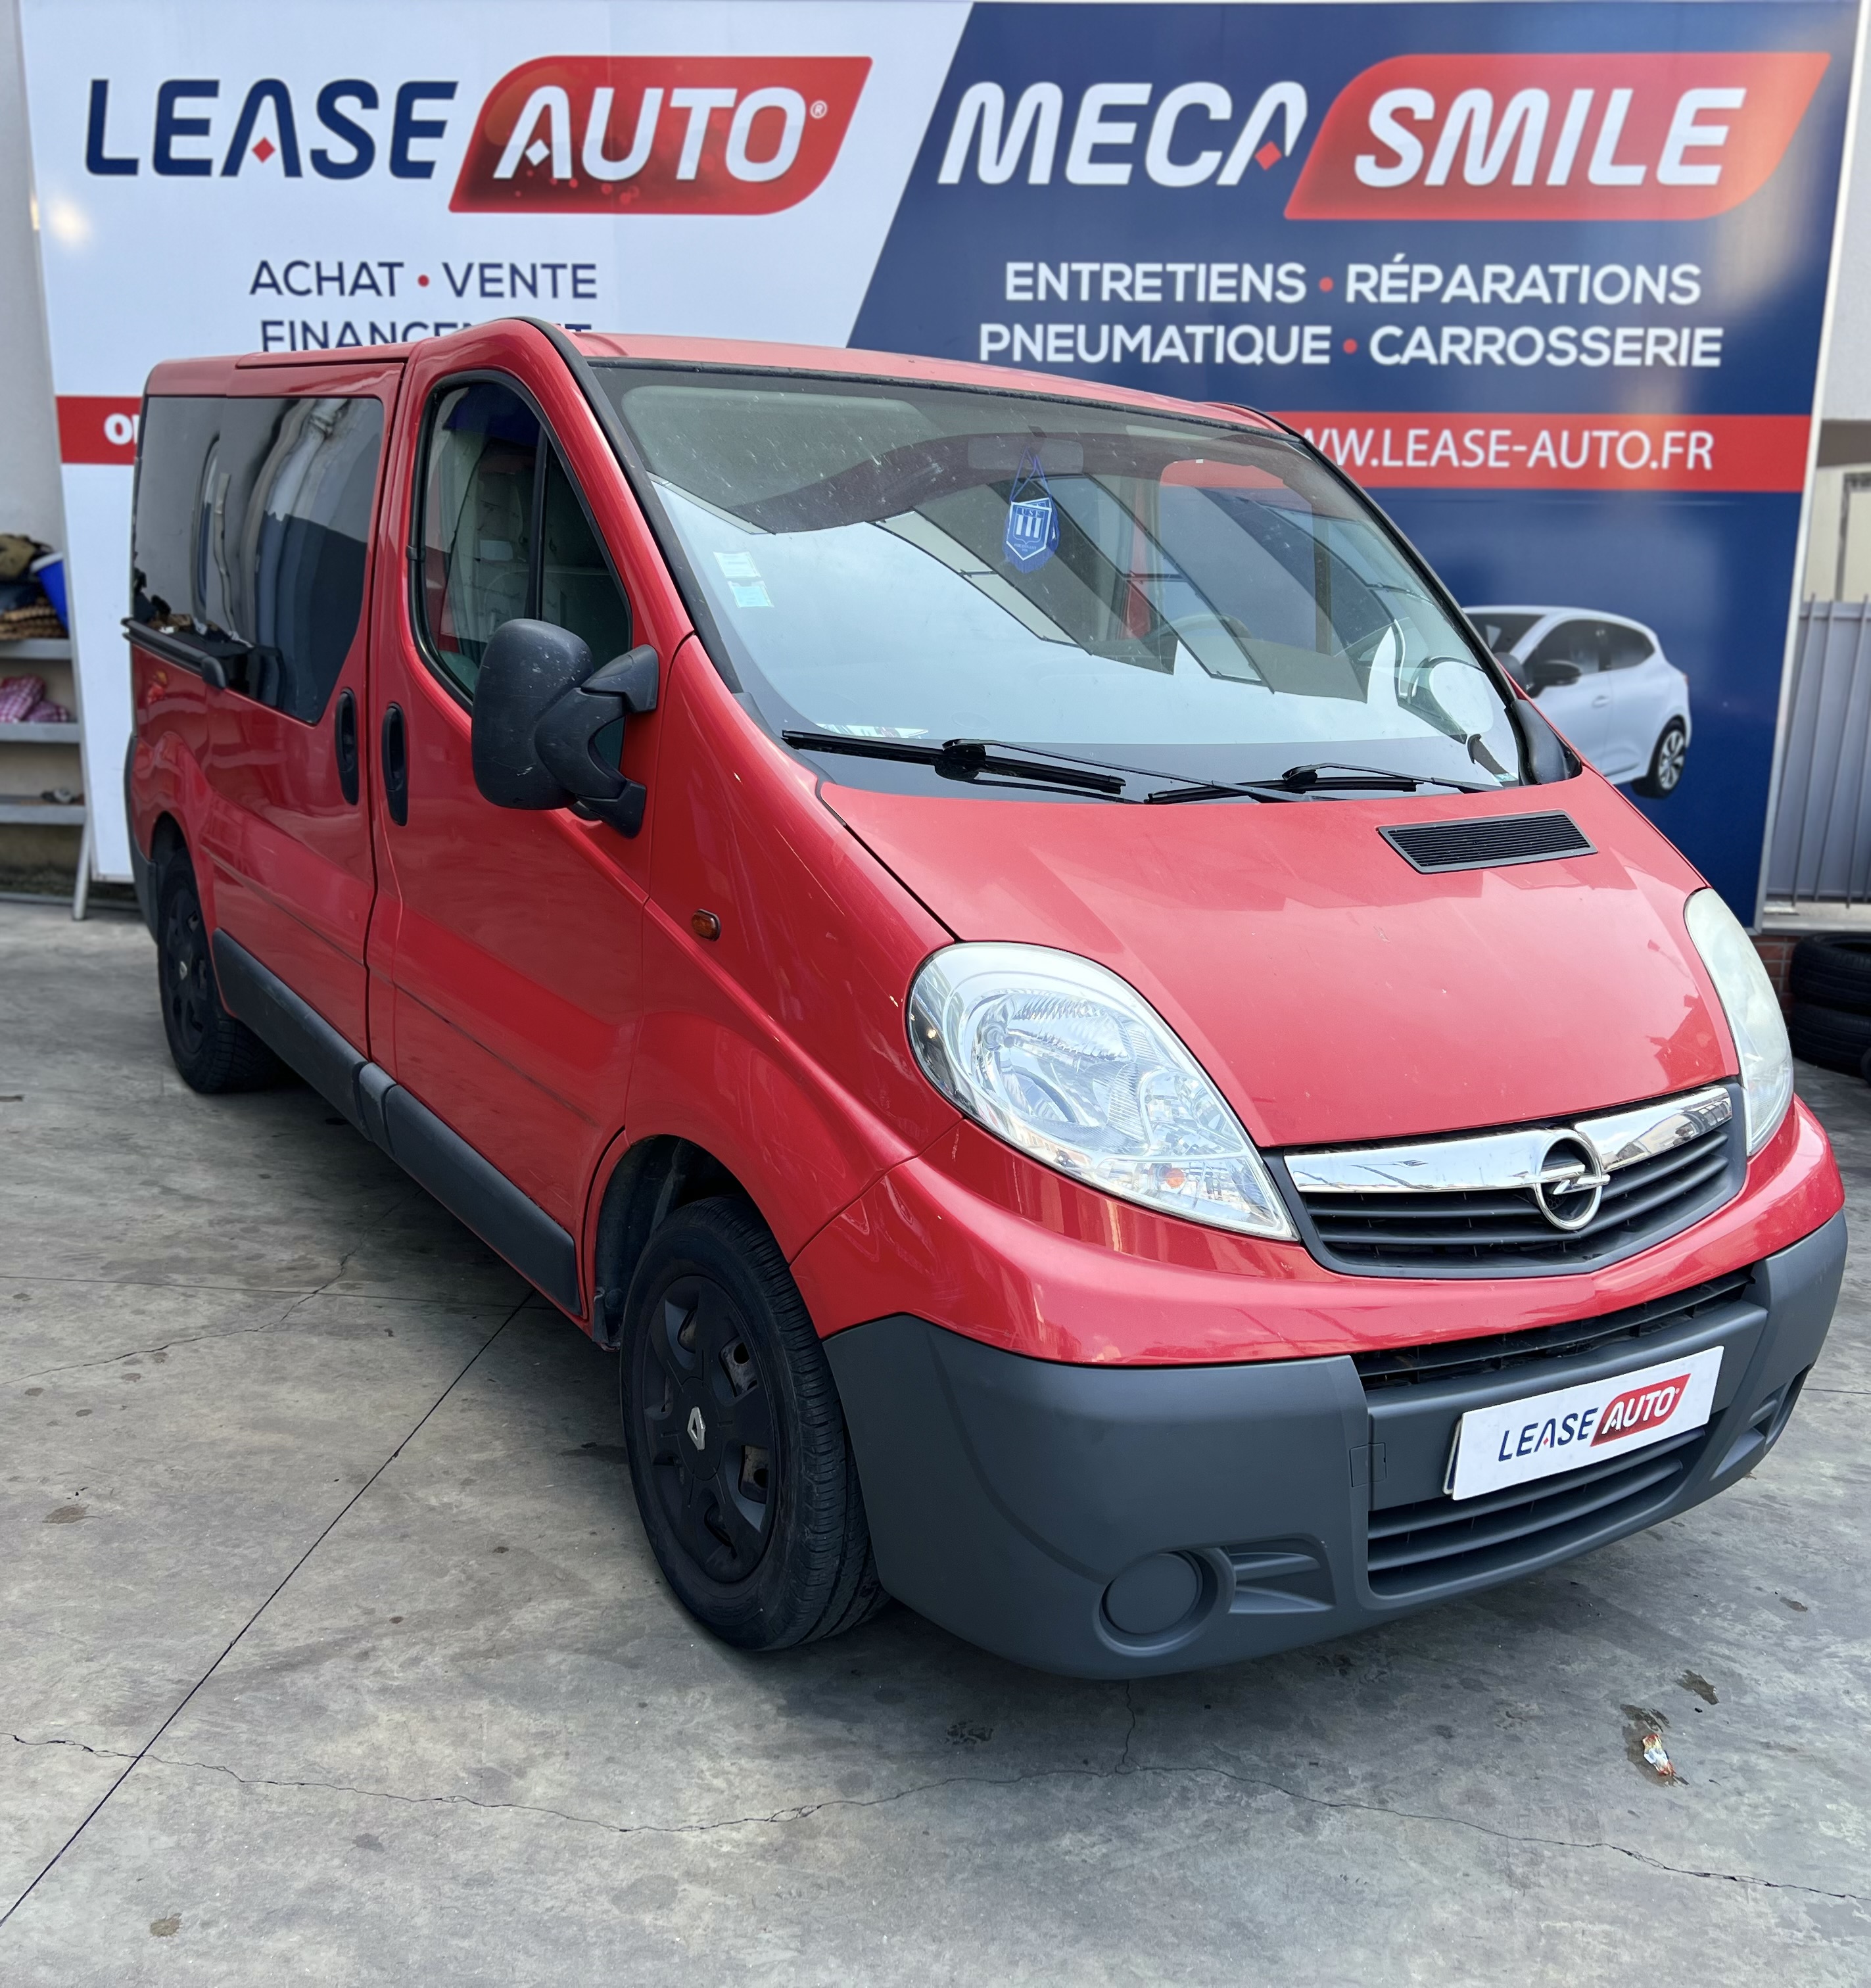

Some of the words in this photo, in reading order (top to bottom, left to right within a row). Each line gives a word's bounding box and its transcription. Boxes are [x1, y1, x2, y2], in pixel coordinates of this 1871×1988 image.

[85, 79, 459, 180] LEASE
[937, 81, 1308, 187] MECA
[1354, 87, 1747, 189] SMILE
[249, 260, 404, 297] ACHAT
[442, 262, 598, 299] VENTE
[1005, 262, 1307, 304] ENTRETIENS
[1346, 253, 1702, 306] RÉPARATIONS
[979, 323, 1332, 367] PNEUMATIQUE
[1369, 325, 1724, 367] CARROSSERIE
[1498, 1407, 1599, 1462] LEASE
